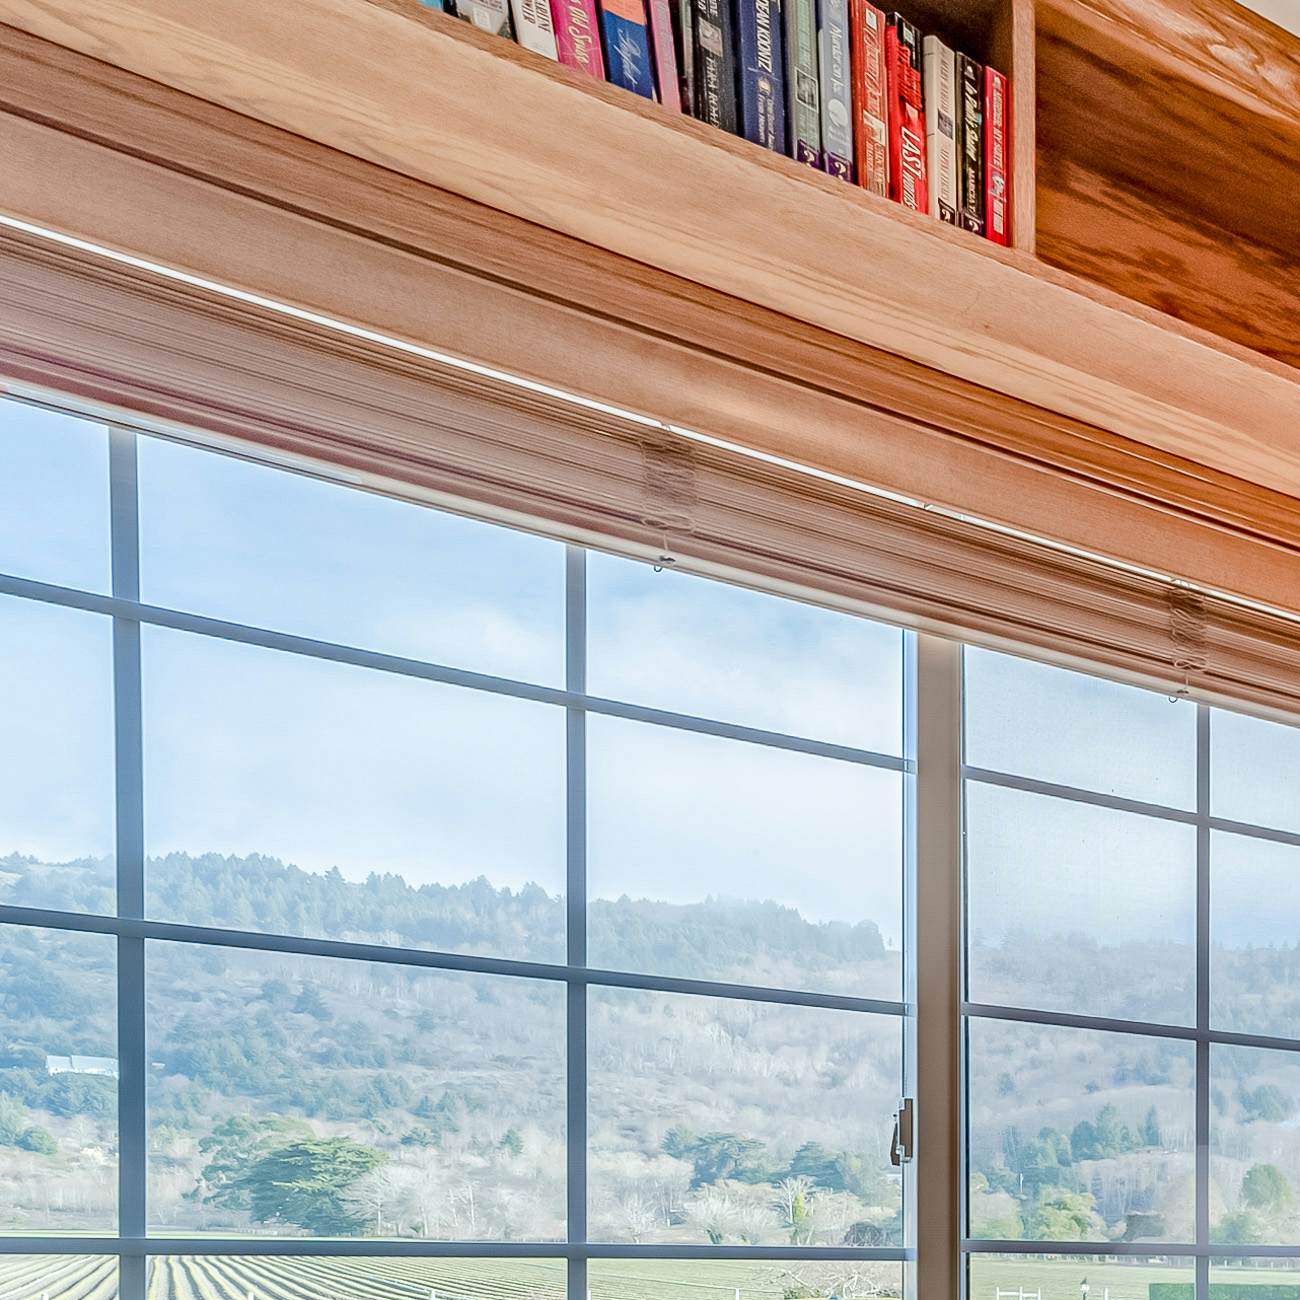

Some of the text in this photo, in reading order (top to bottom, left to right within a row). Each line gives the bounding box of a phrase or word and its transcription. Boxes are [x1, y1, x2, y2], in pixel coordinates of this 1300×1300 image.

[758, 26, 772, 72] KOONTZ
[901, 127, 921, 178] LAST
[904, 174, 916, 210] words
